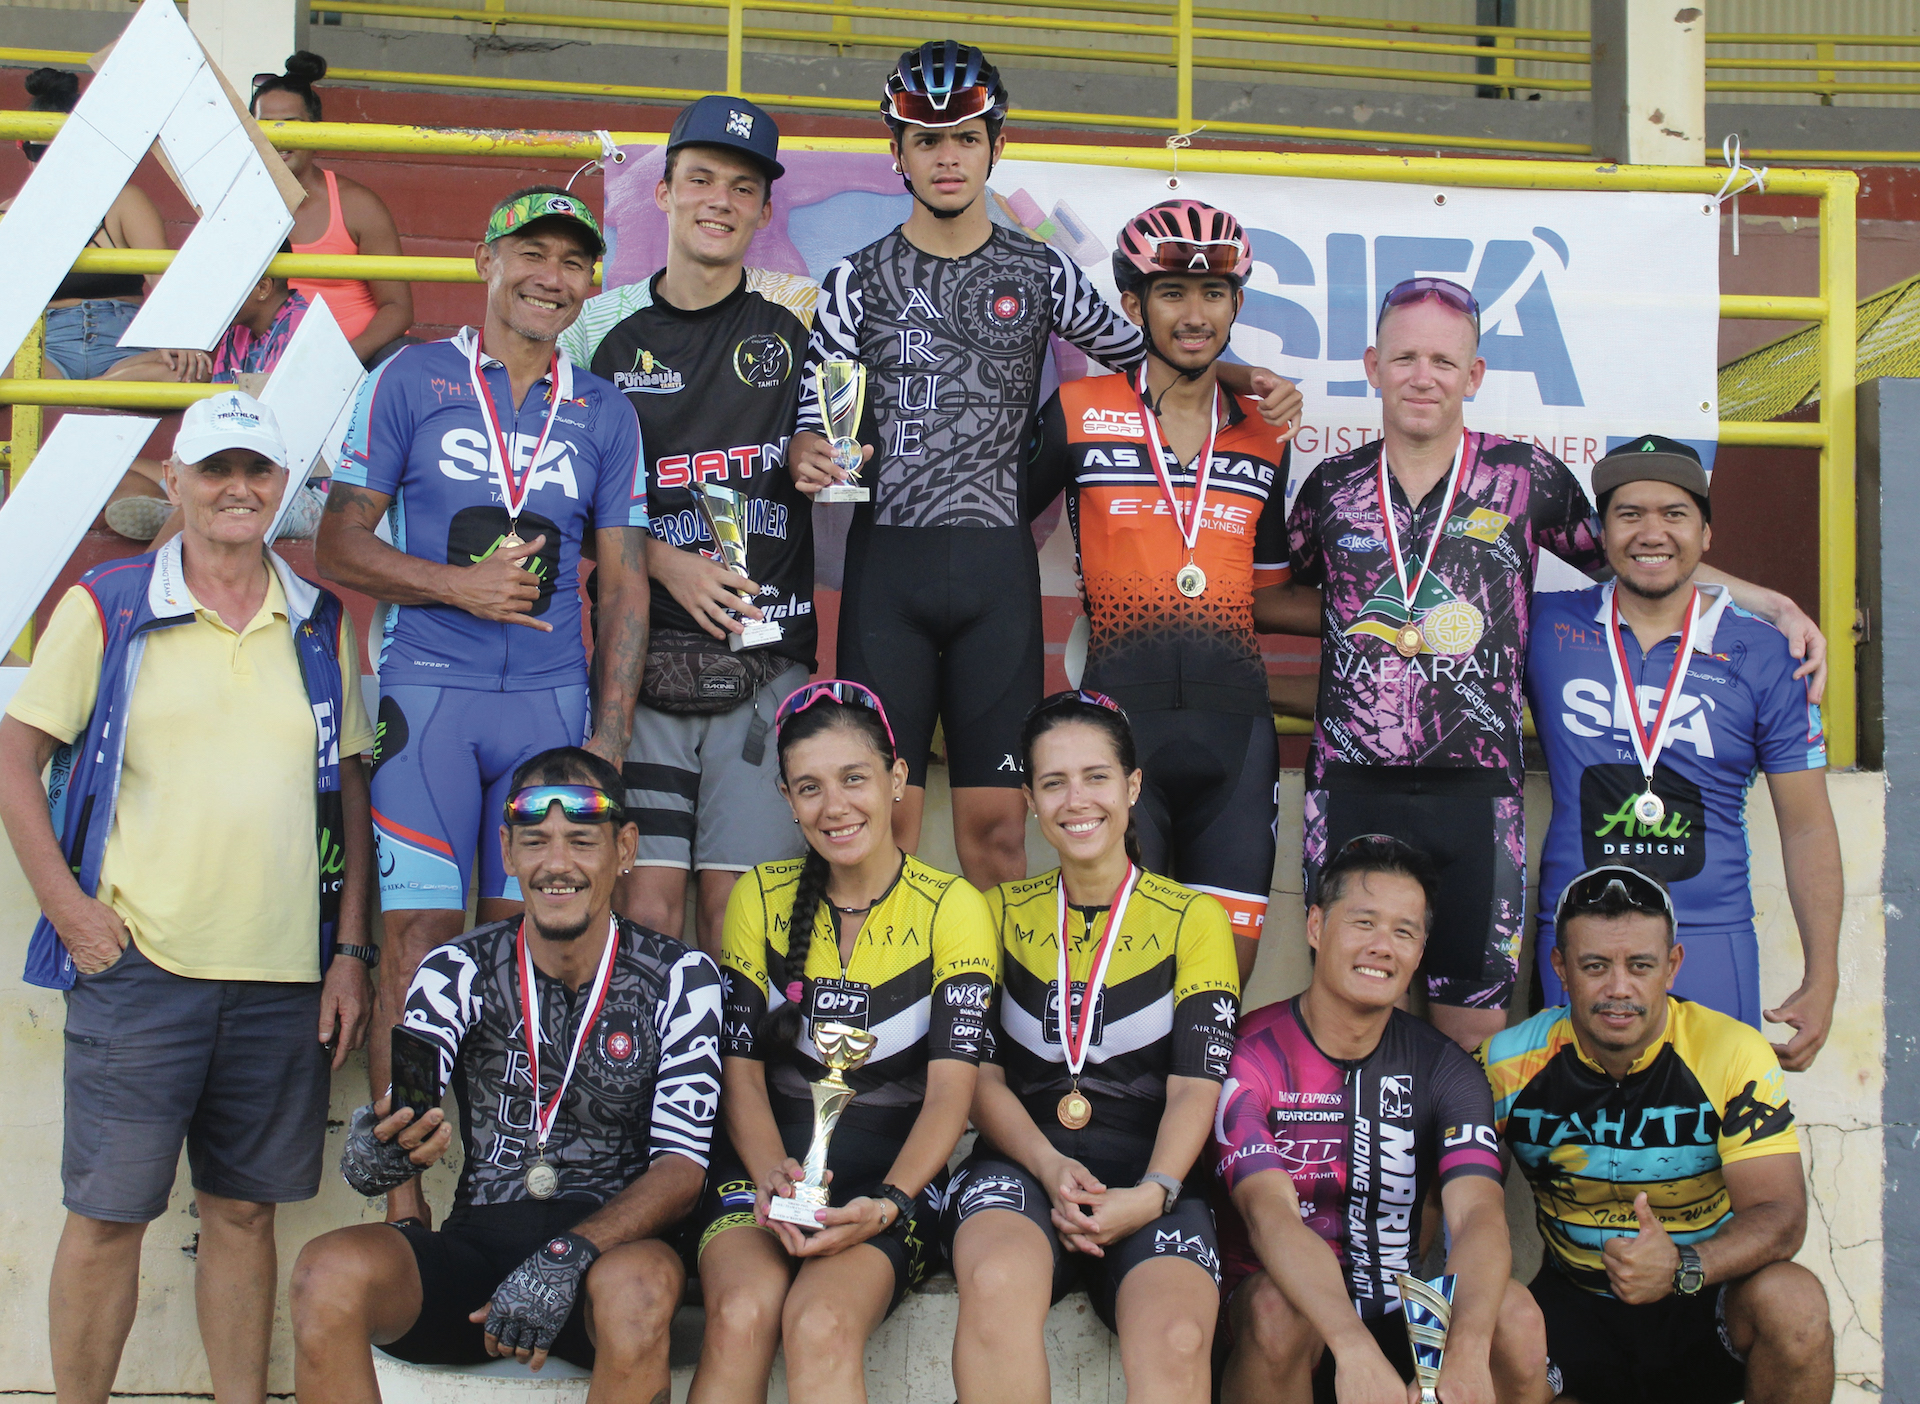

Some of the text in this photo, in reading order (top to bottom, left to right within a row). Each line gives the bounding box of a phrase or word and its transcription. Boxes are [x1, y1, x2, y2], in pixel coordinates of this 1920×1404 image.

[614, 370, 682, 388] Punaauia
[890, 287, 944, 457] ARUE
[758, 379, 779, 388] TAHITI
[1084, 422, 1144, 436] SPORT
[1083, 448, 1141, 467] AS
[1336, 511, 1384, 521] OROHEN
[1447, 516, 1503, 533] MOKO
[1199, 517, 1245, 536] OLYNESIA
[163, 578, 171, 597] TEAM
[1454, 682, 1506, 732] OROHENA
[1323, 716, 1371, 765] OROHE
[1604, 843, 1685, 855] DESIGN
[1145, 879, 1192, 900] hybrid
[735, 955, 752, 971] TE
[948, 957, 990, 970] THAN
[945, 983, 991, 1012] WSK
[1174, 980, 1237, 1003] ORE THAN
[817, 991, 865, 1013] OPT
[724, 1021, 753, 1039] NA
[953, 1024, 982, 1038] OPT
[1191, 1023, 1210, 1034] AIR
[1208, 1044, 1233, 1061] OPT
[1302, 1092, 1342, 1105] EXPRESS
[1513, 1101, 1716, 1147] TAHITI
[1352, 1116, 1371, 1193] RIDING
[1309, 1171, 1339, 1180] TAHITI
[960, 1180, 1019, 1205] OPT
[1594, 1193, 1727, 1224] Teahoo Wave
[1348, 1195, 1369, 1252] TEAM
[1155, 1229, 1221, 1271] MAN
